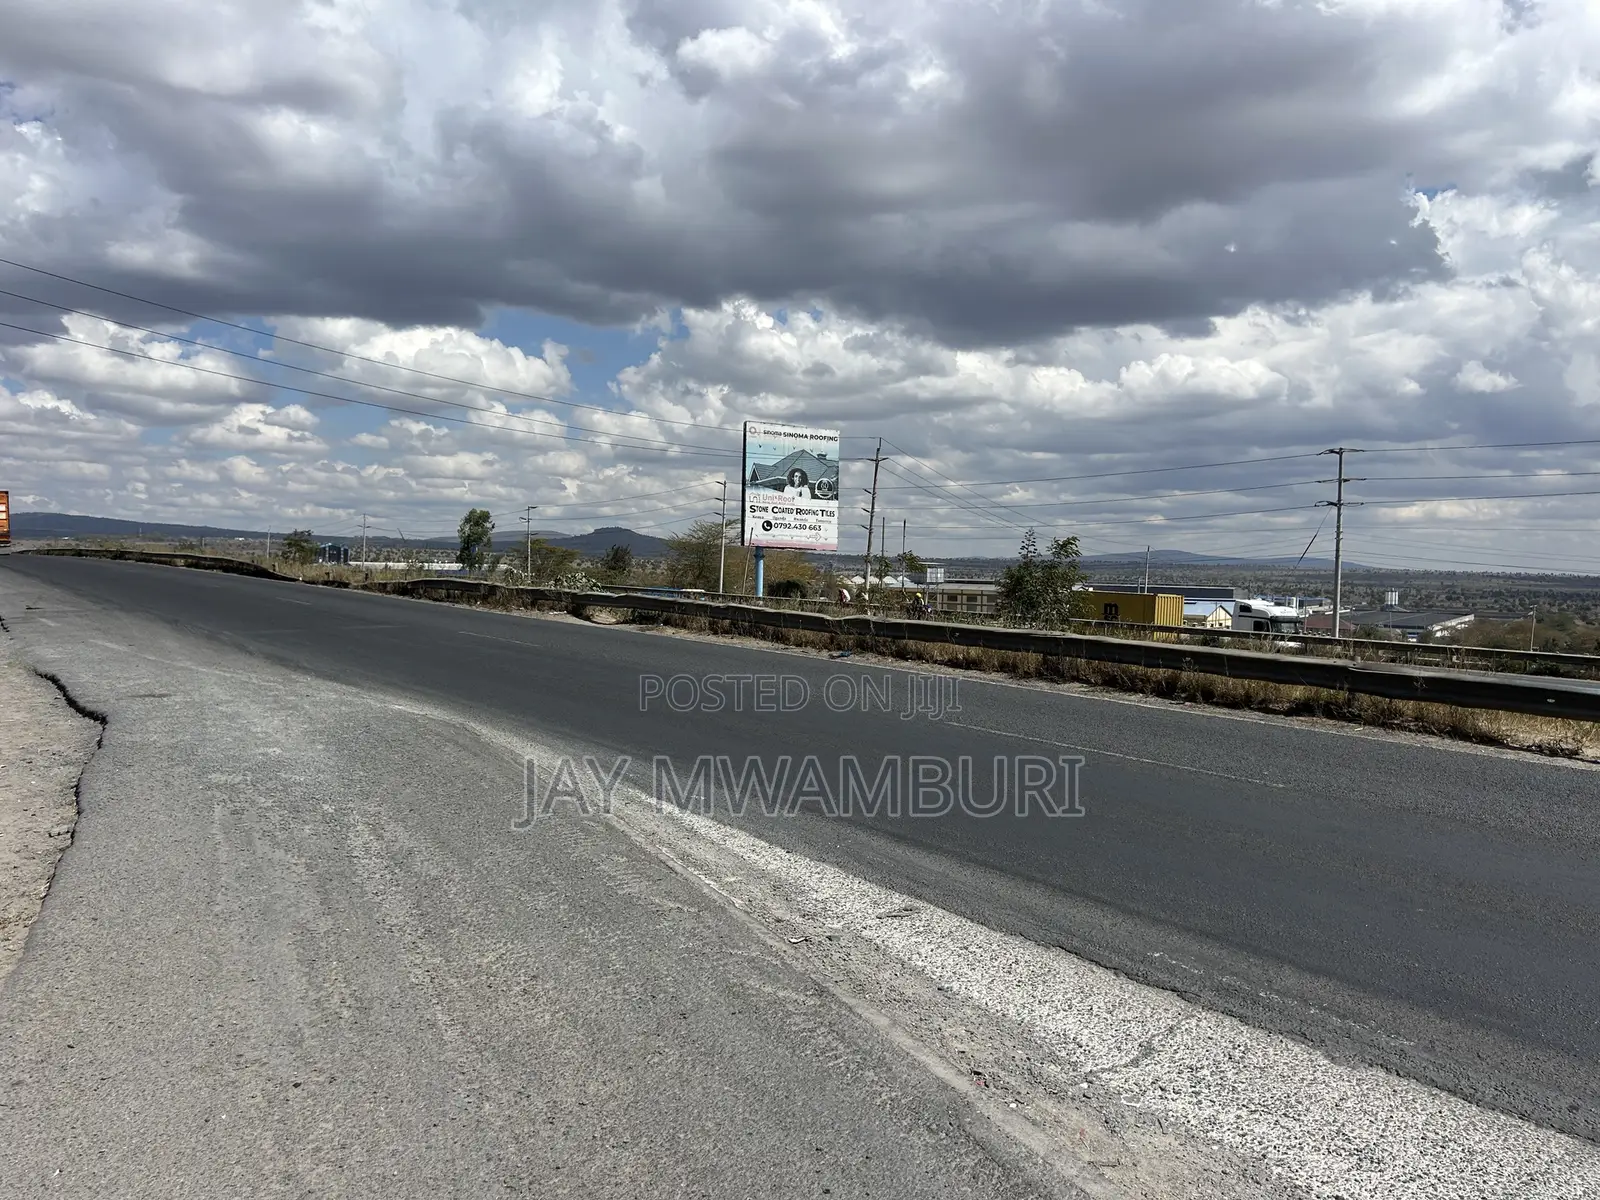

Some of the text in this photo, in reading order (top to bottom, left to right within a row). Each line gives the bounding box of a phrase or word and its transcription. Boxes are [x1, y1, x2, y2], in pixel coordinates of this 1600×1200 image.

[783, 431, 808, 440] SINOMA
[809, 434, 838, 442] ROOFING
[749, 505, 836, 518] STONE COATED ROOFING TILES
